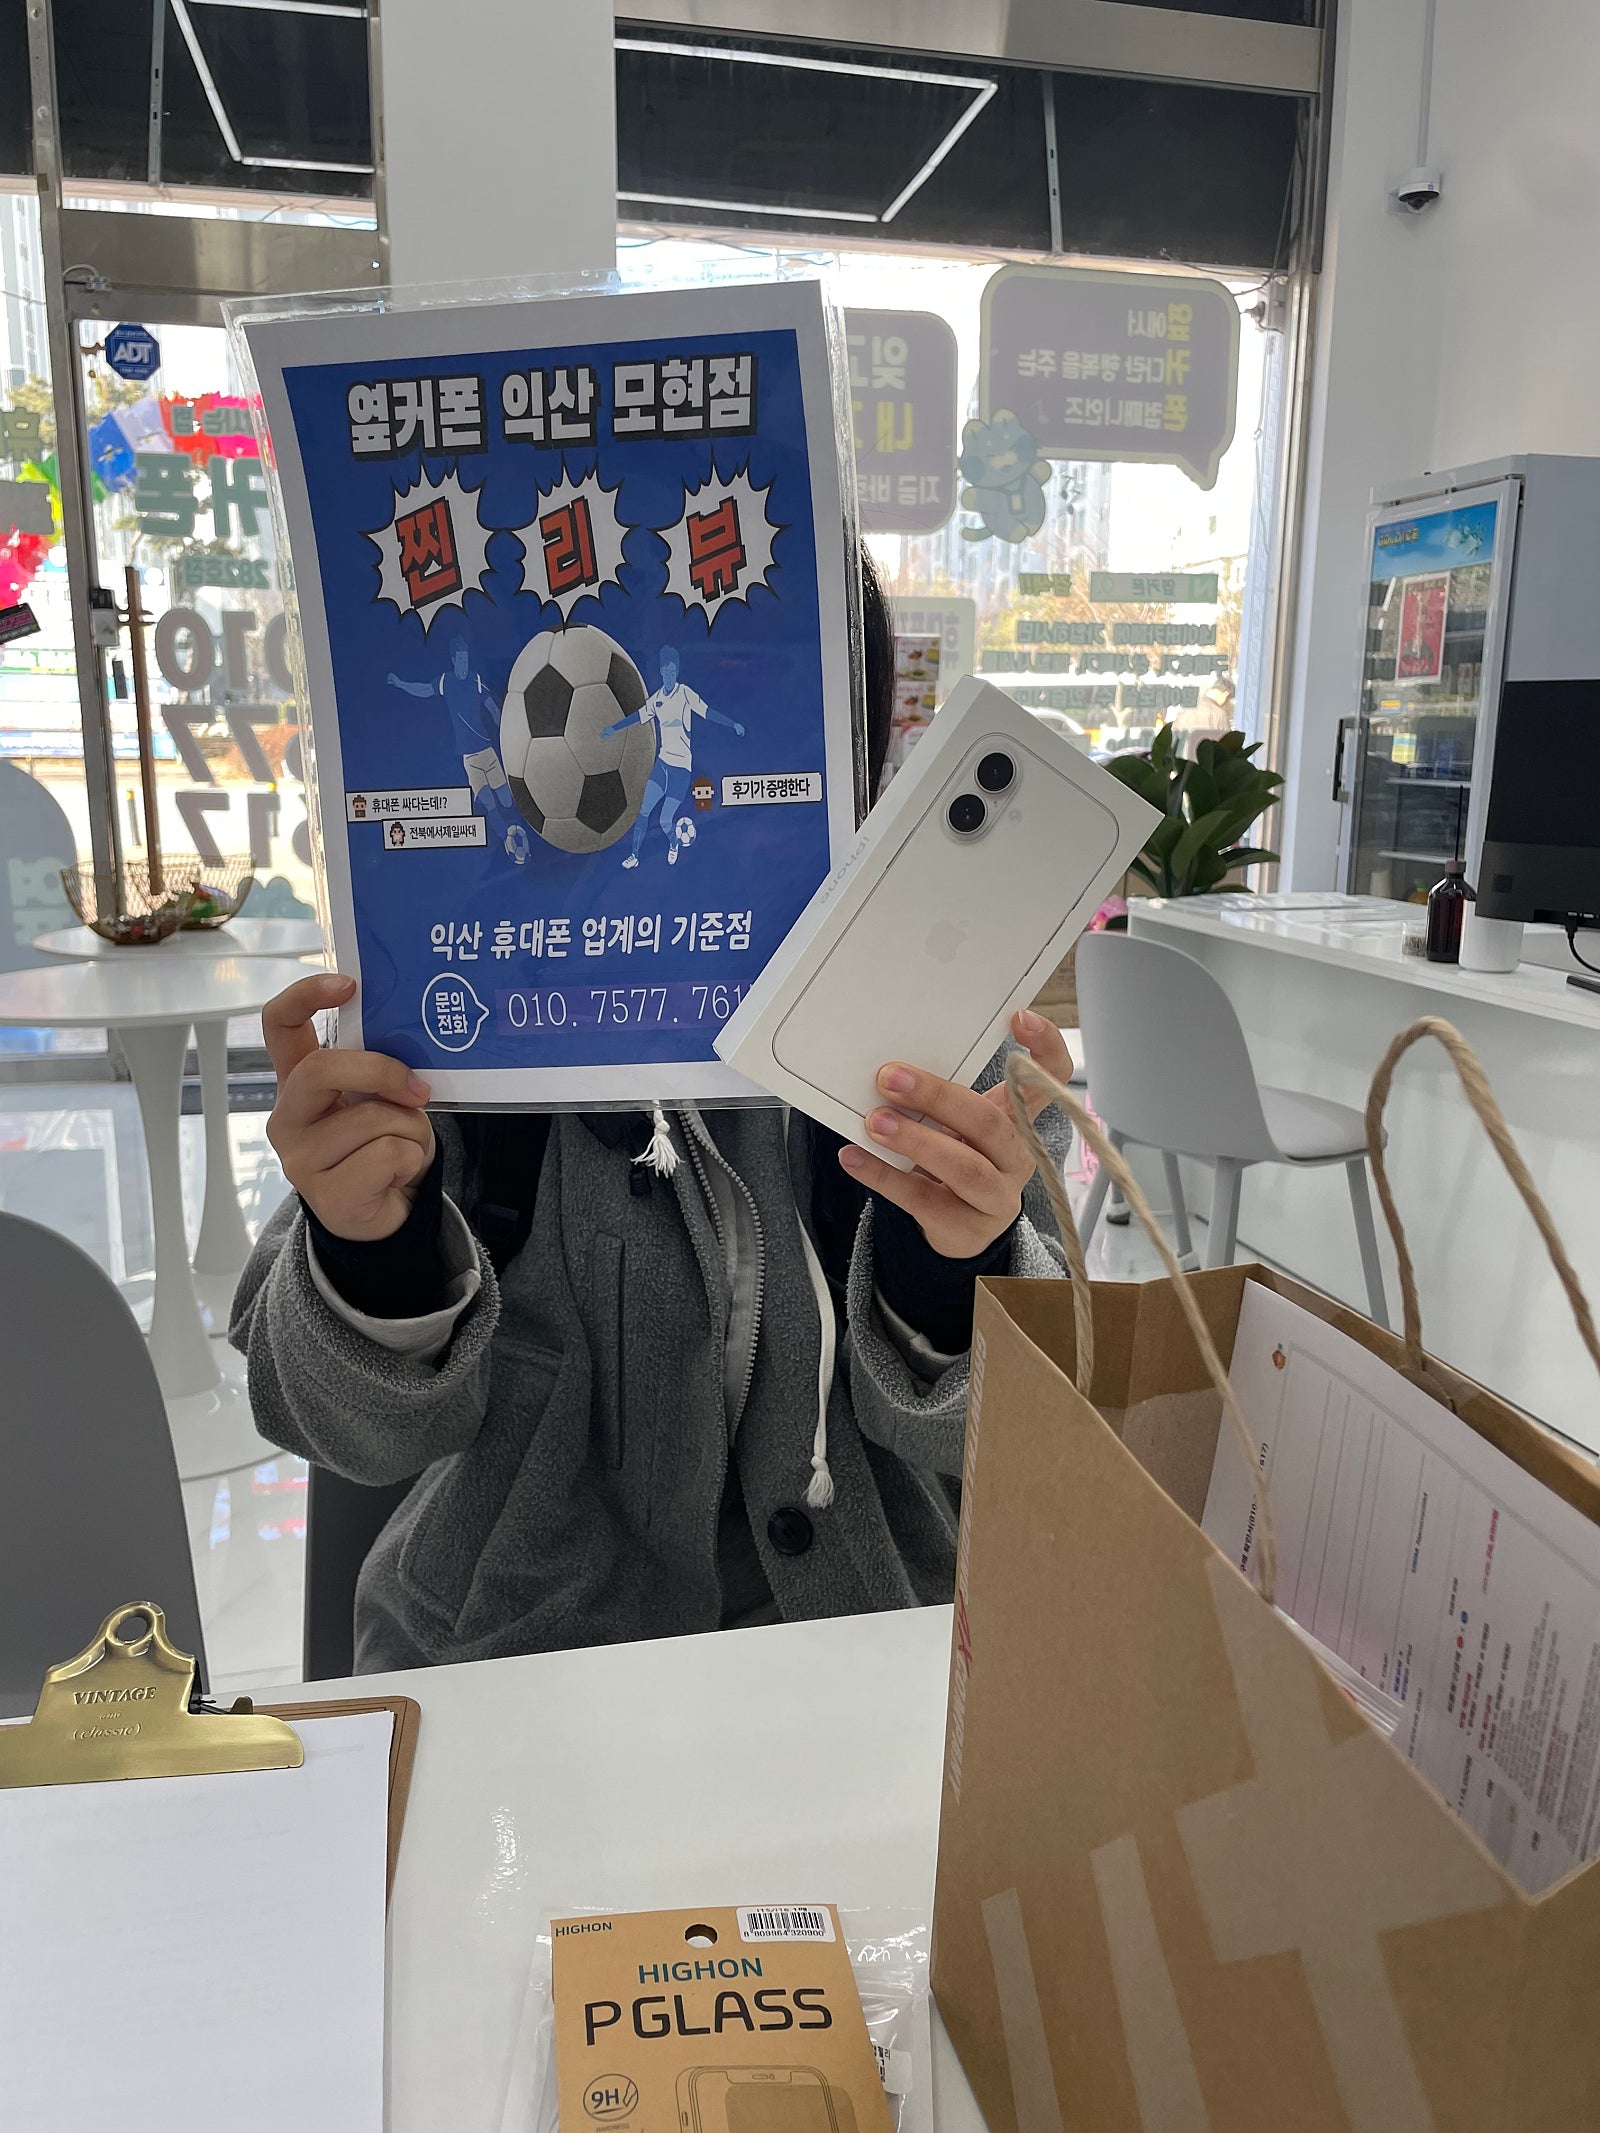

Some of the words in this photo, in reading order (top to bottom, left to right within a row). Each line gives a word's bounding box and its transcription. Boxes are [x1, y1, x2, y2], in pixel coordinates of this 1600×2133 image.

[113, 341, 152, 364] ADT
[347, 376, 485, 456] 옆커폰
[501, 367, 595, 443] 익산
[612, 355, 755, 434] 모현점
[395, 497, 463, 607] 찐
[539, 495, 599, 597] 리
[687, 497, 748, 601] 뷰
[732, 780, 766, 800] 후기가
[765, 778, 811, 799] 증명한다
[371, 797, 400, 814] 휴대폰
[401, 795, 448, 812] 싸다는데!?
[409, 824, 477, 840] 전북에서제일싸대
[430, 919, 483, 962] 익산
[490, 917, 571, 960] 휴대폰
[581, 913, 661, 955] 업계의
[670, 910, 754, 952] 기준점
[434, 991, 466, 1014] 문의
[507, 991, 578, 1028] 010.
[590, 988, 679, 1024] 7577.
[692, 983, 755, 1020] 761
[436, 1012, 470, 1037] 전화
[73, 1686, 157, 1706] VINTAGE
[72, 1721, 143, 1742] (classic)
[948, 1648, 968, 1807] COMPANY
[554, 1921, 613, 1938] HIGHON
[637, 1957, 764, 1985] HIGHON
[591, 2088, 619, 2109] 9H
